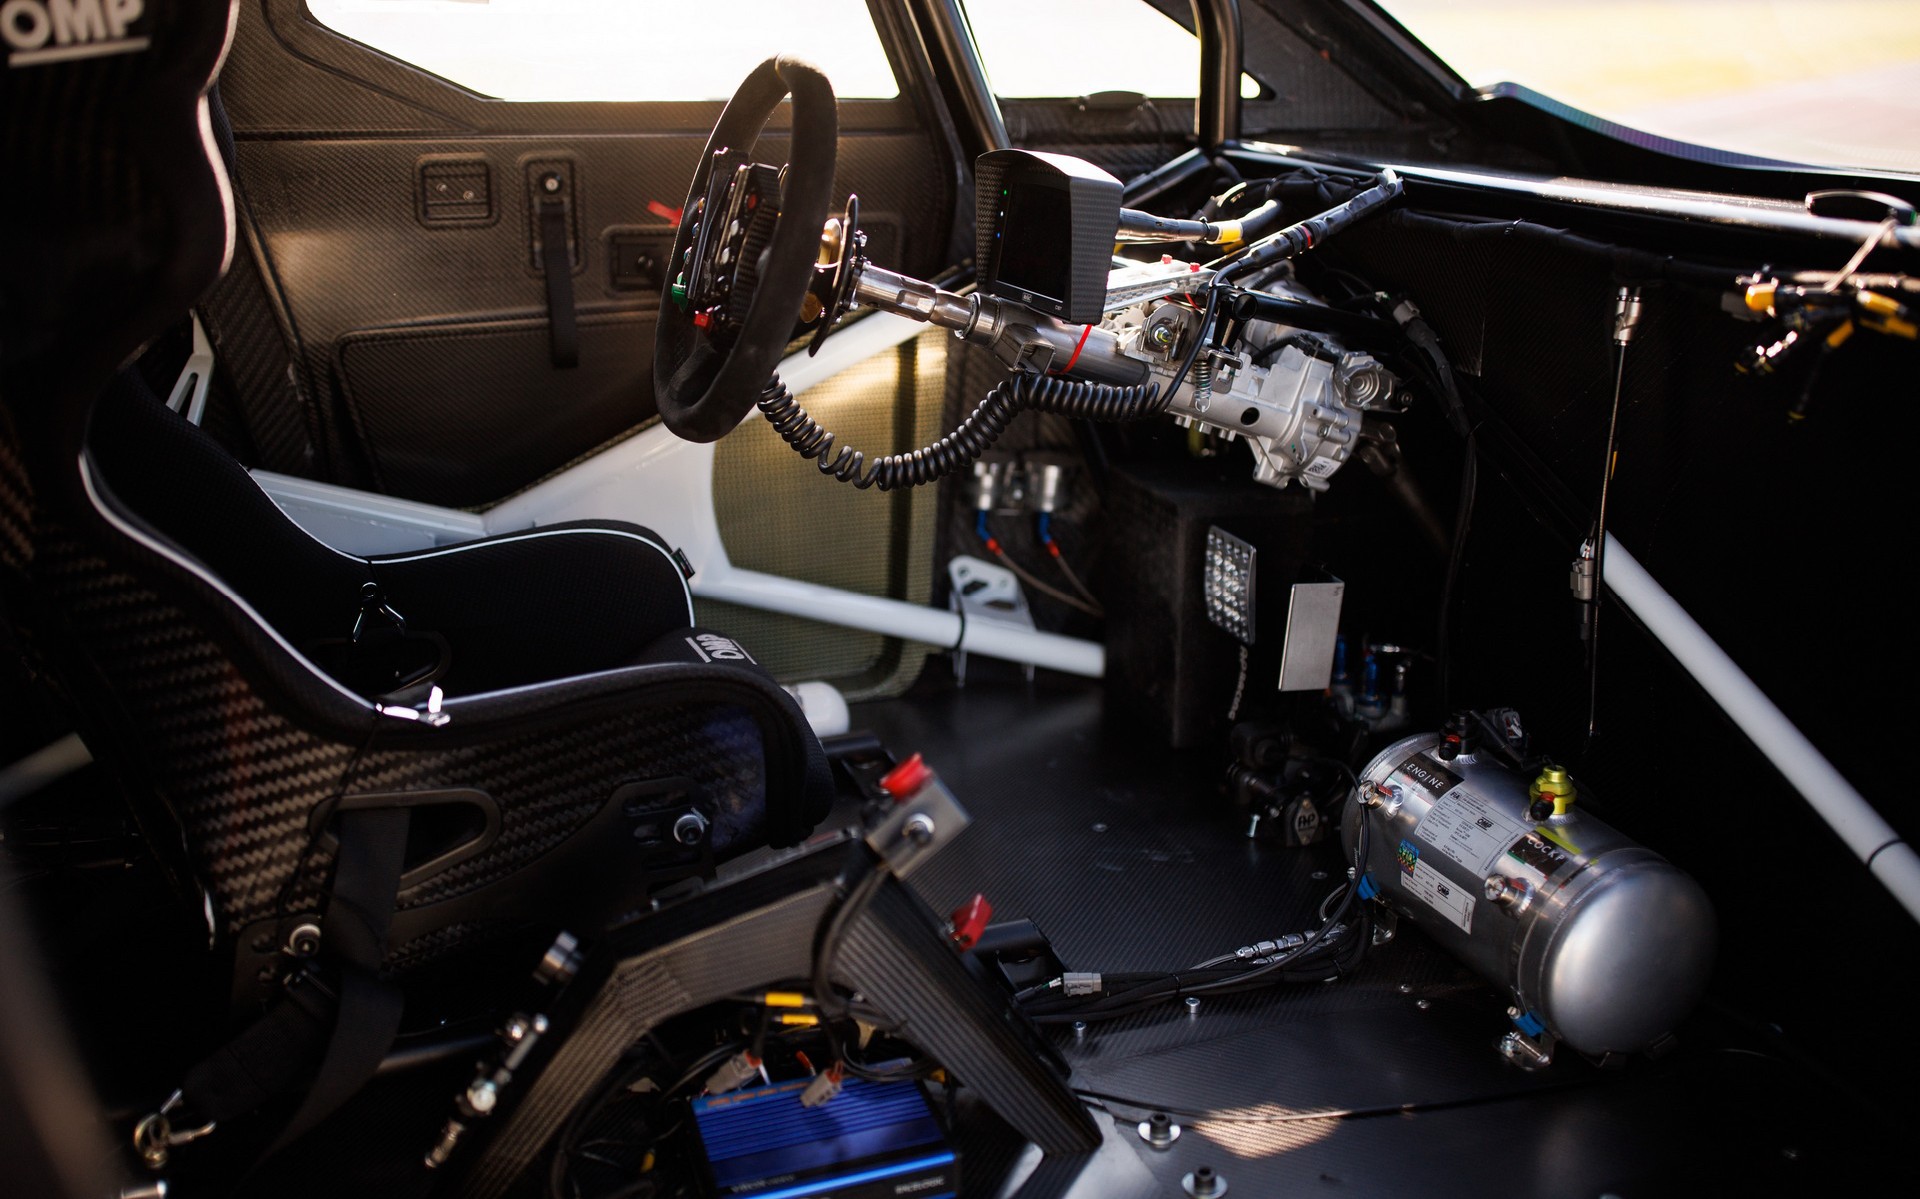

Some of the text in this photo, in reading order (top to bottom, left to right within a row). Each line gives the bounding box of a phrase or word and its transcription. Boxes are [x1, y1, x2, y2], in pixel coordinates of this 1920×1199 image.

[0, 0, 146, 49] OMP
[695, 633, 745, 660] OMP
[1406, 763, 1444, 789] ENGINE
